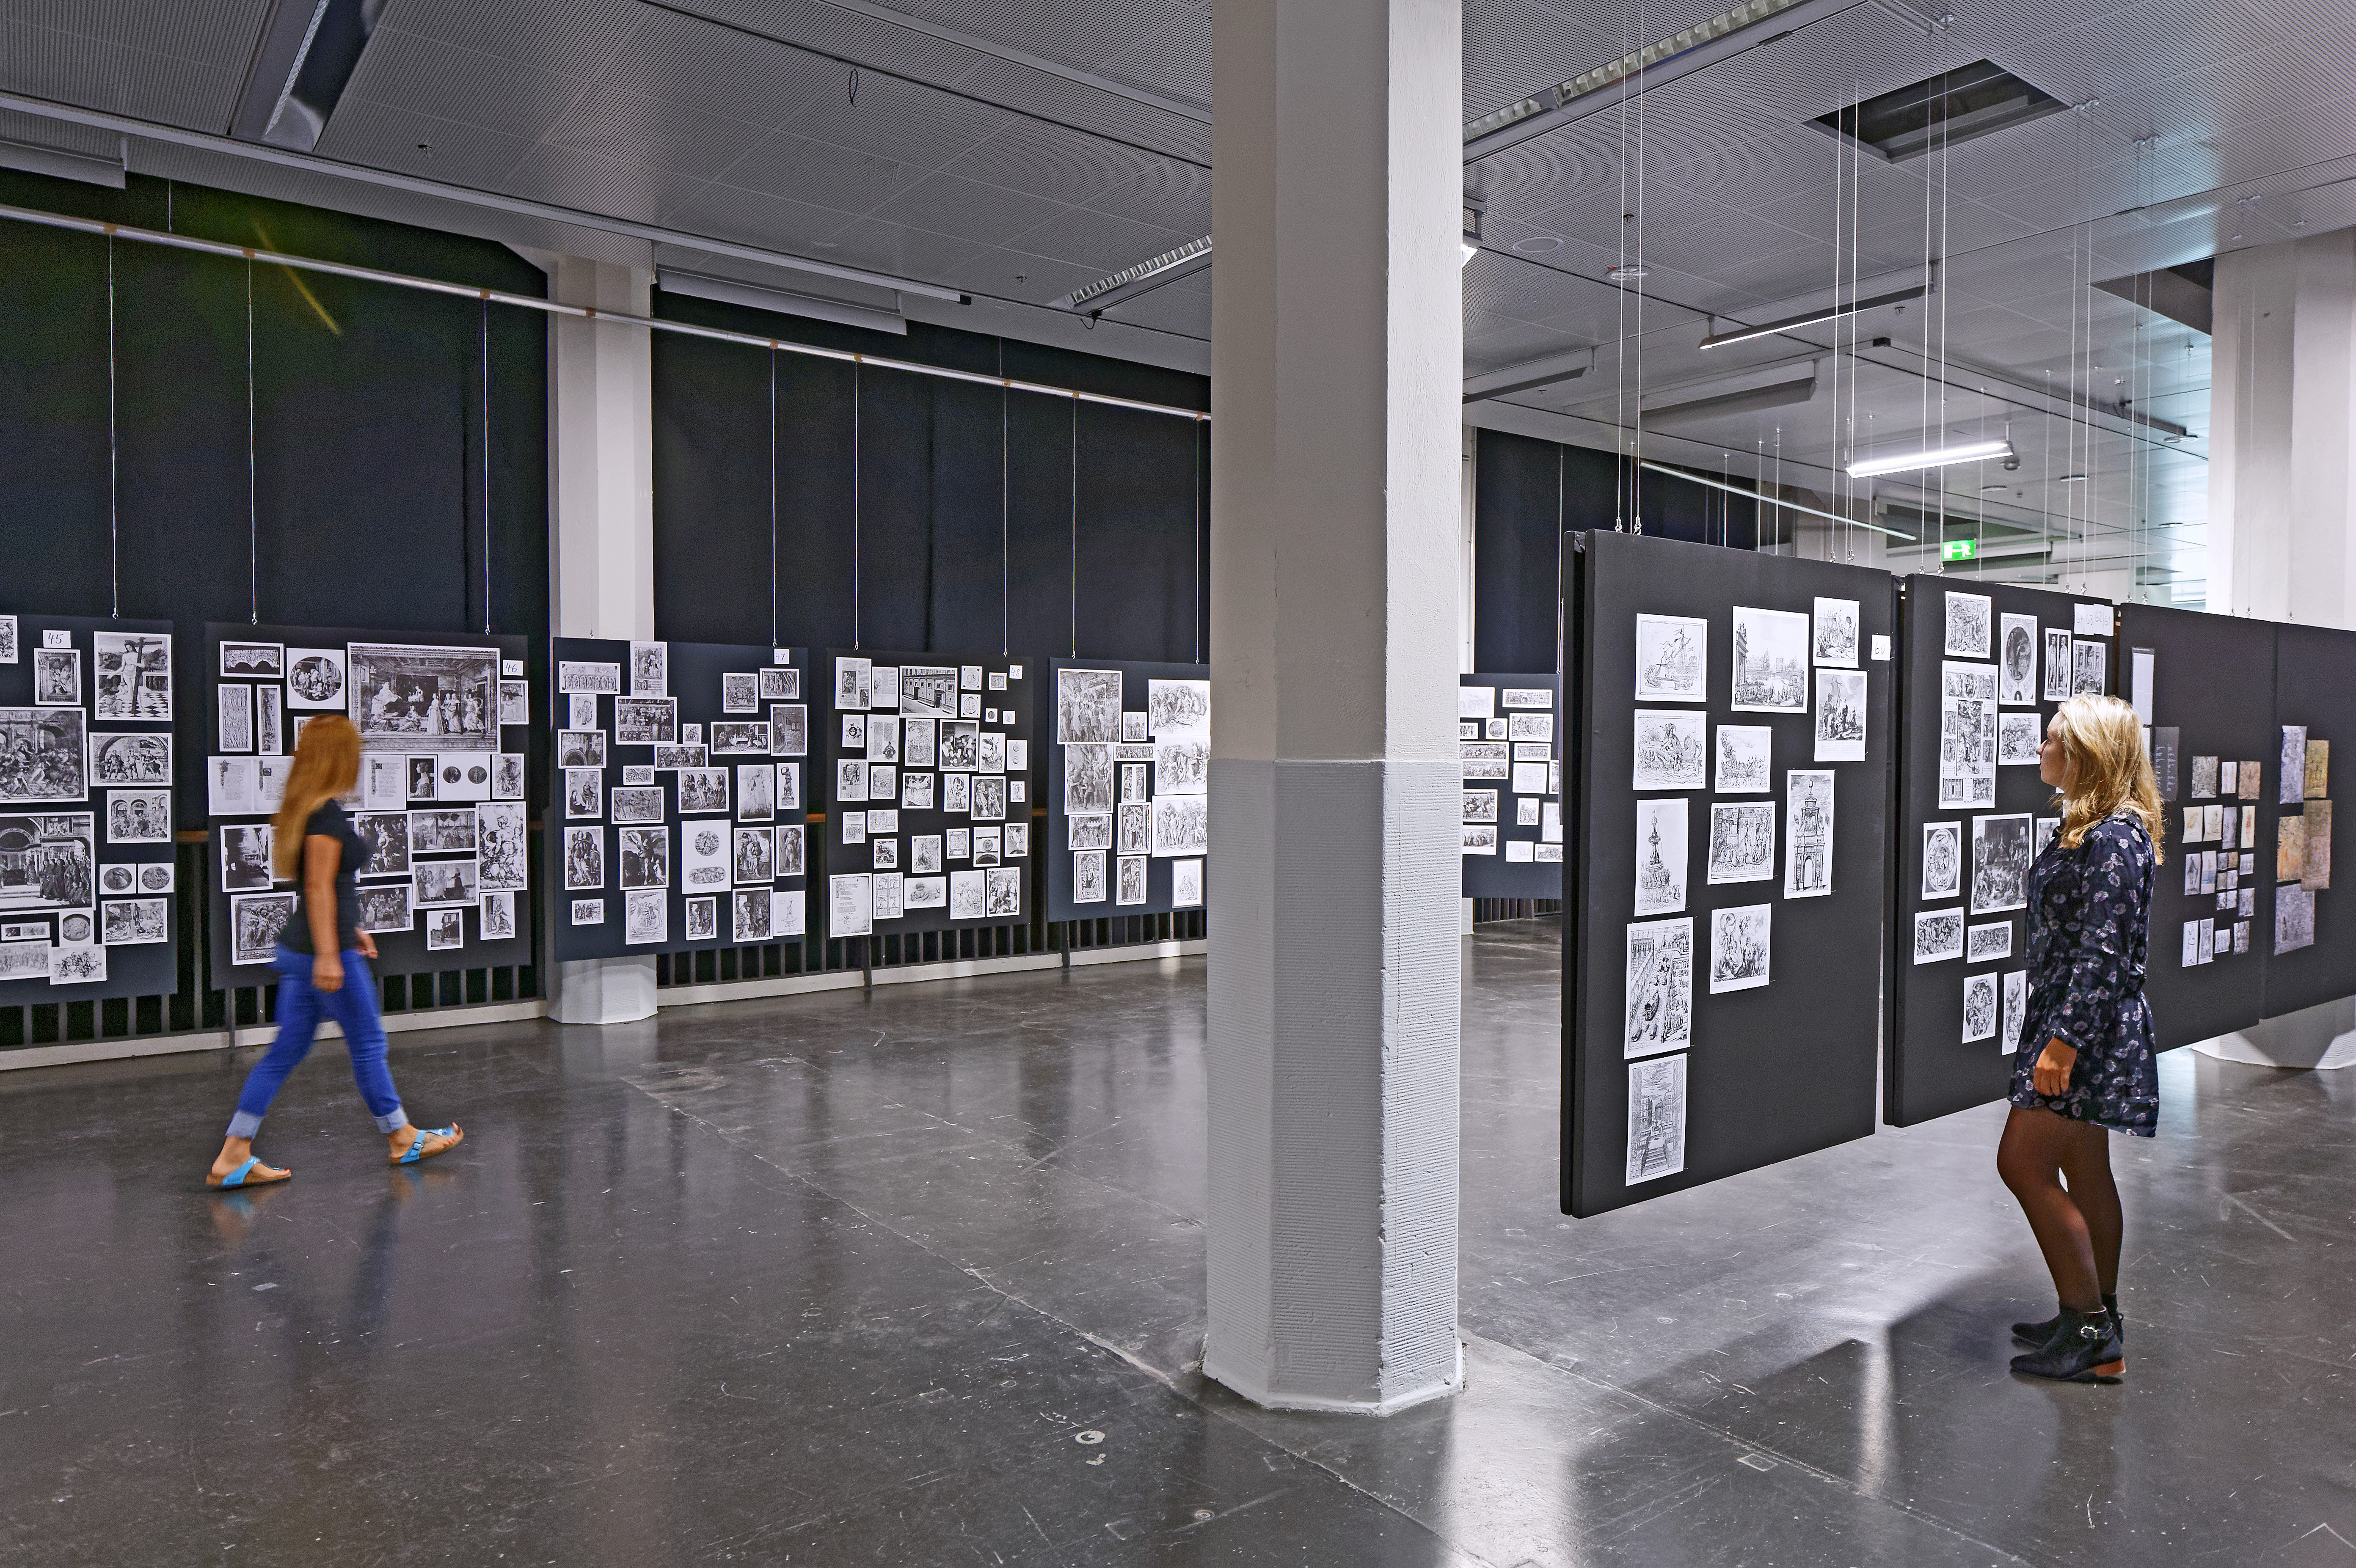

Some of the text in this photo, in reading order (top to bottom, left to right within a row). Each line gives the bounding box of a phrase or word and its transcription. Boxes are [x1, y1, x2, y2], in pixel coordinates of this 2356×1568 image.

[2076, 611, 2110, 626] 64 63 62 61
[48, 633, 64, 644] 45
[1875, 641, 1885, 654] 60
[775, 652, 785, 661] 47
[505, 663, 517, 672] 46
[1011, 668, 1020, 677] 48
